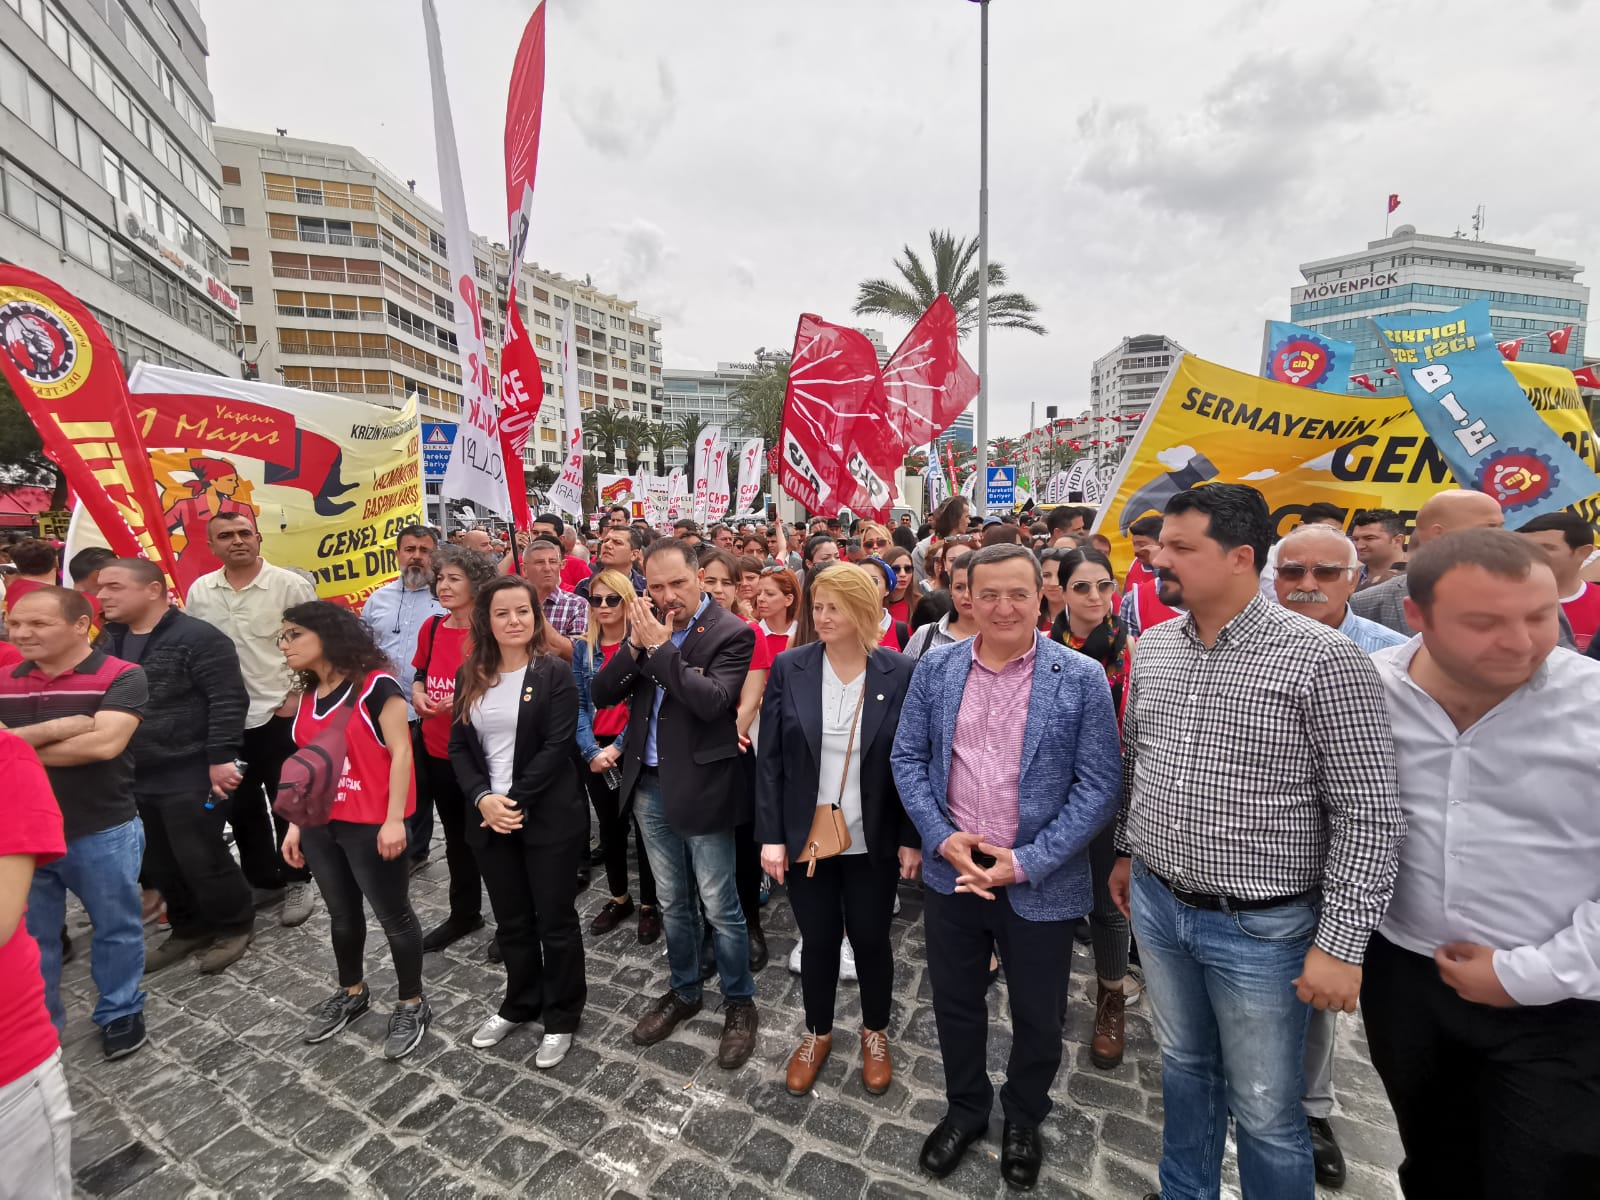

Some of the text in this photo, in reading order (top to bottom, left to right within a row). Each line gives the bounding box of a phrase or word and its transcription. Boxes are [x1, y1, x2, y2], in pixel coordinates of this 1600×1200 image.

[216, 404, 275, 424] Yaşasın
[1181, 387, 1376, 440] SERMAYENİN
[136, 407, 280, 451] 1 Mayıs
[351, 424, 381, 440] KRİZİN
[1331, 435, 1459, 483] GEN
[1068, 466, 1083, 490] HDP
[1085, 479, 1098, 502] HDP
[317, 524, 377, 558] GENEL
[364, 546, 400, 576] DİR
